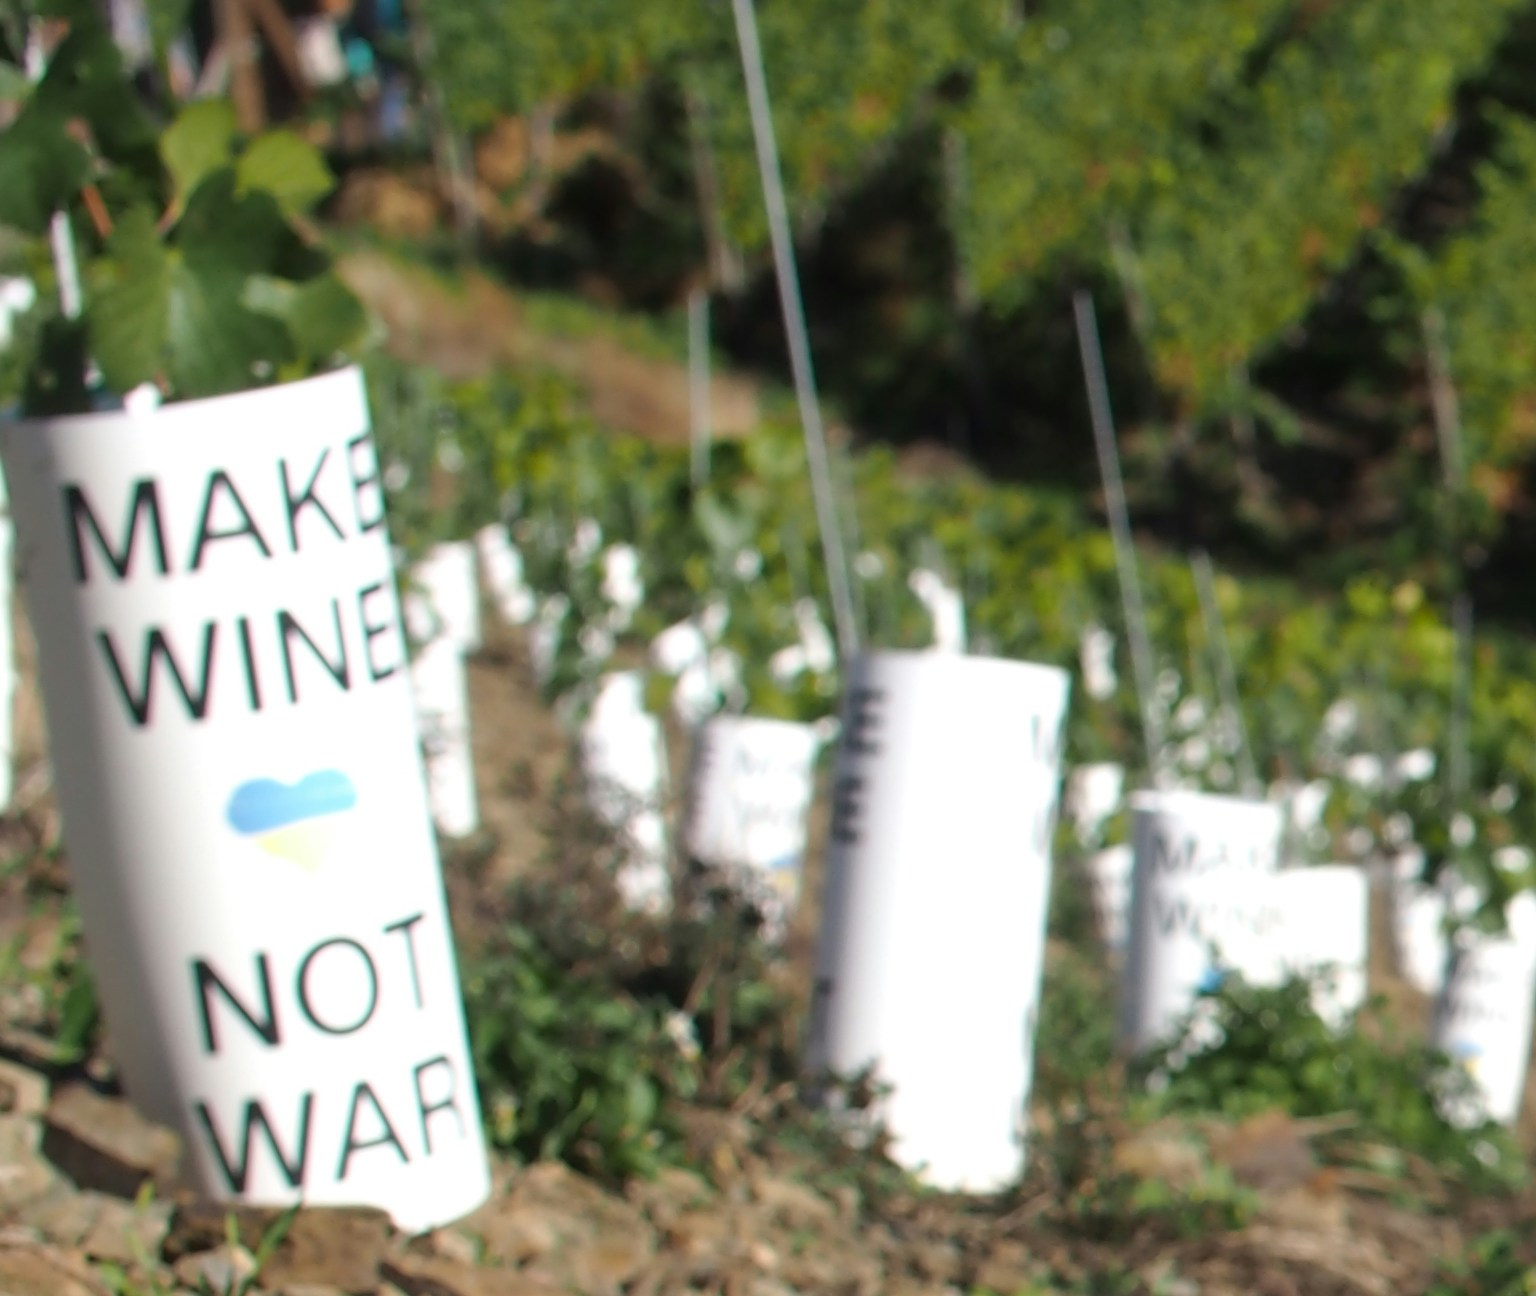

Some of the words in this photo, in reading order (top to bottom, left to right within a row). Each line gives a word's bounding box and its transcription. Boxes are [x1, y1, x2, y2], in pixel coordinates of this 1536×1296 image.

[61, 432, 386, 582] MAKE
[96, 582, 399, 726] WINE
[190, 911, 425, 1055] NOT
[193, 1054, 465, 1194] WAR
